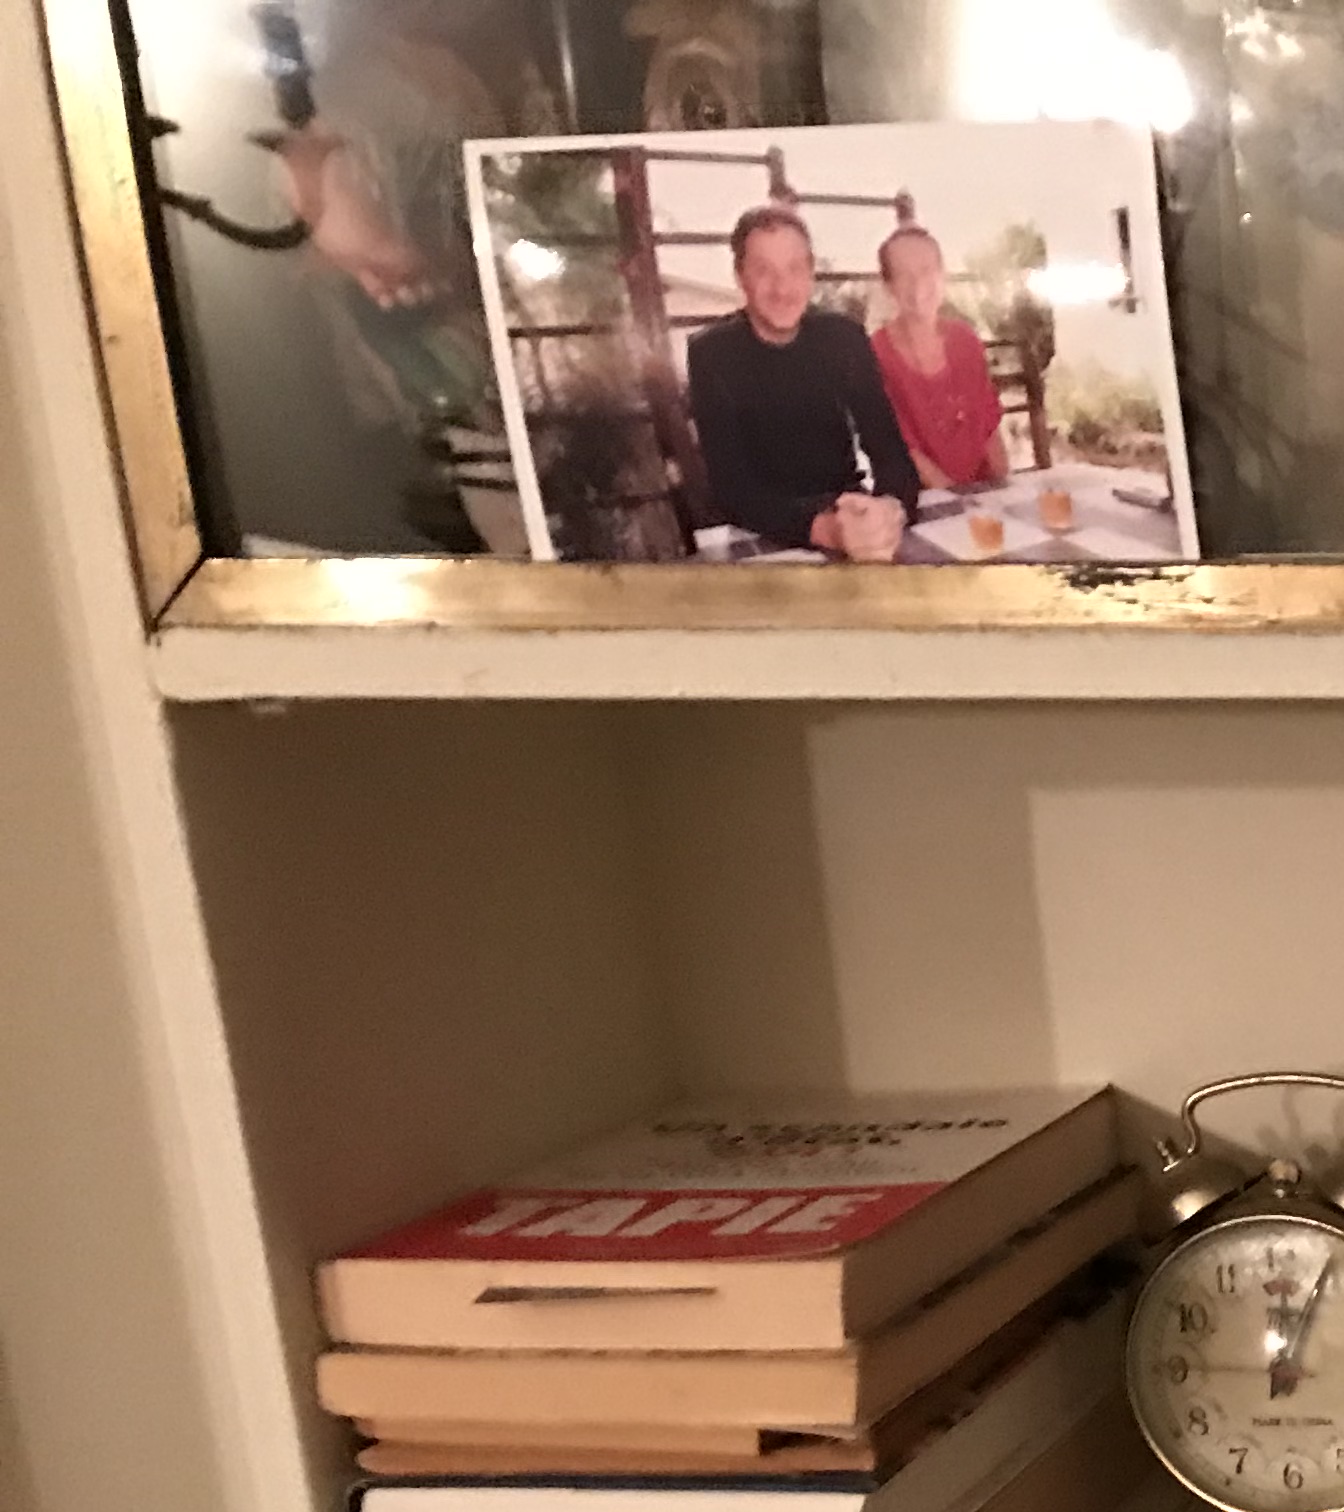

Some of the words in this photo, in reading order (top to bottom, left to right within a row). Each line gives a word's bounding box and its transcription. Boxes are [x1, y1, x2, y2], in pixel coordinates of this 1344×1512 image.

[459, 1193, 884, 1238] TAPIE
[1215, 1263, 1236, 1294] 11
[1179, 1302, 1209, 1334] 10
[1187, 1405, 1210, 1436] 8
[1228, 1447, 1249, 1475] 7
[1282, 1461, 1304, 1490] 6
